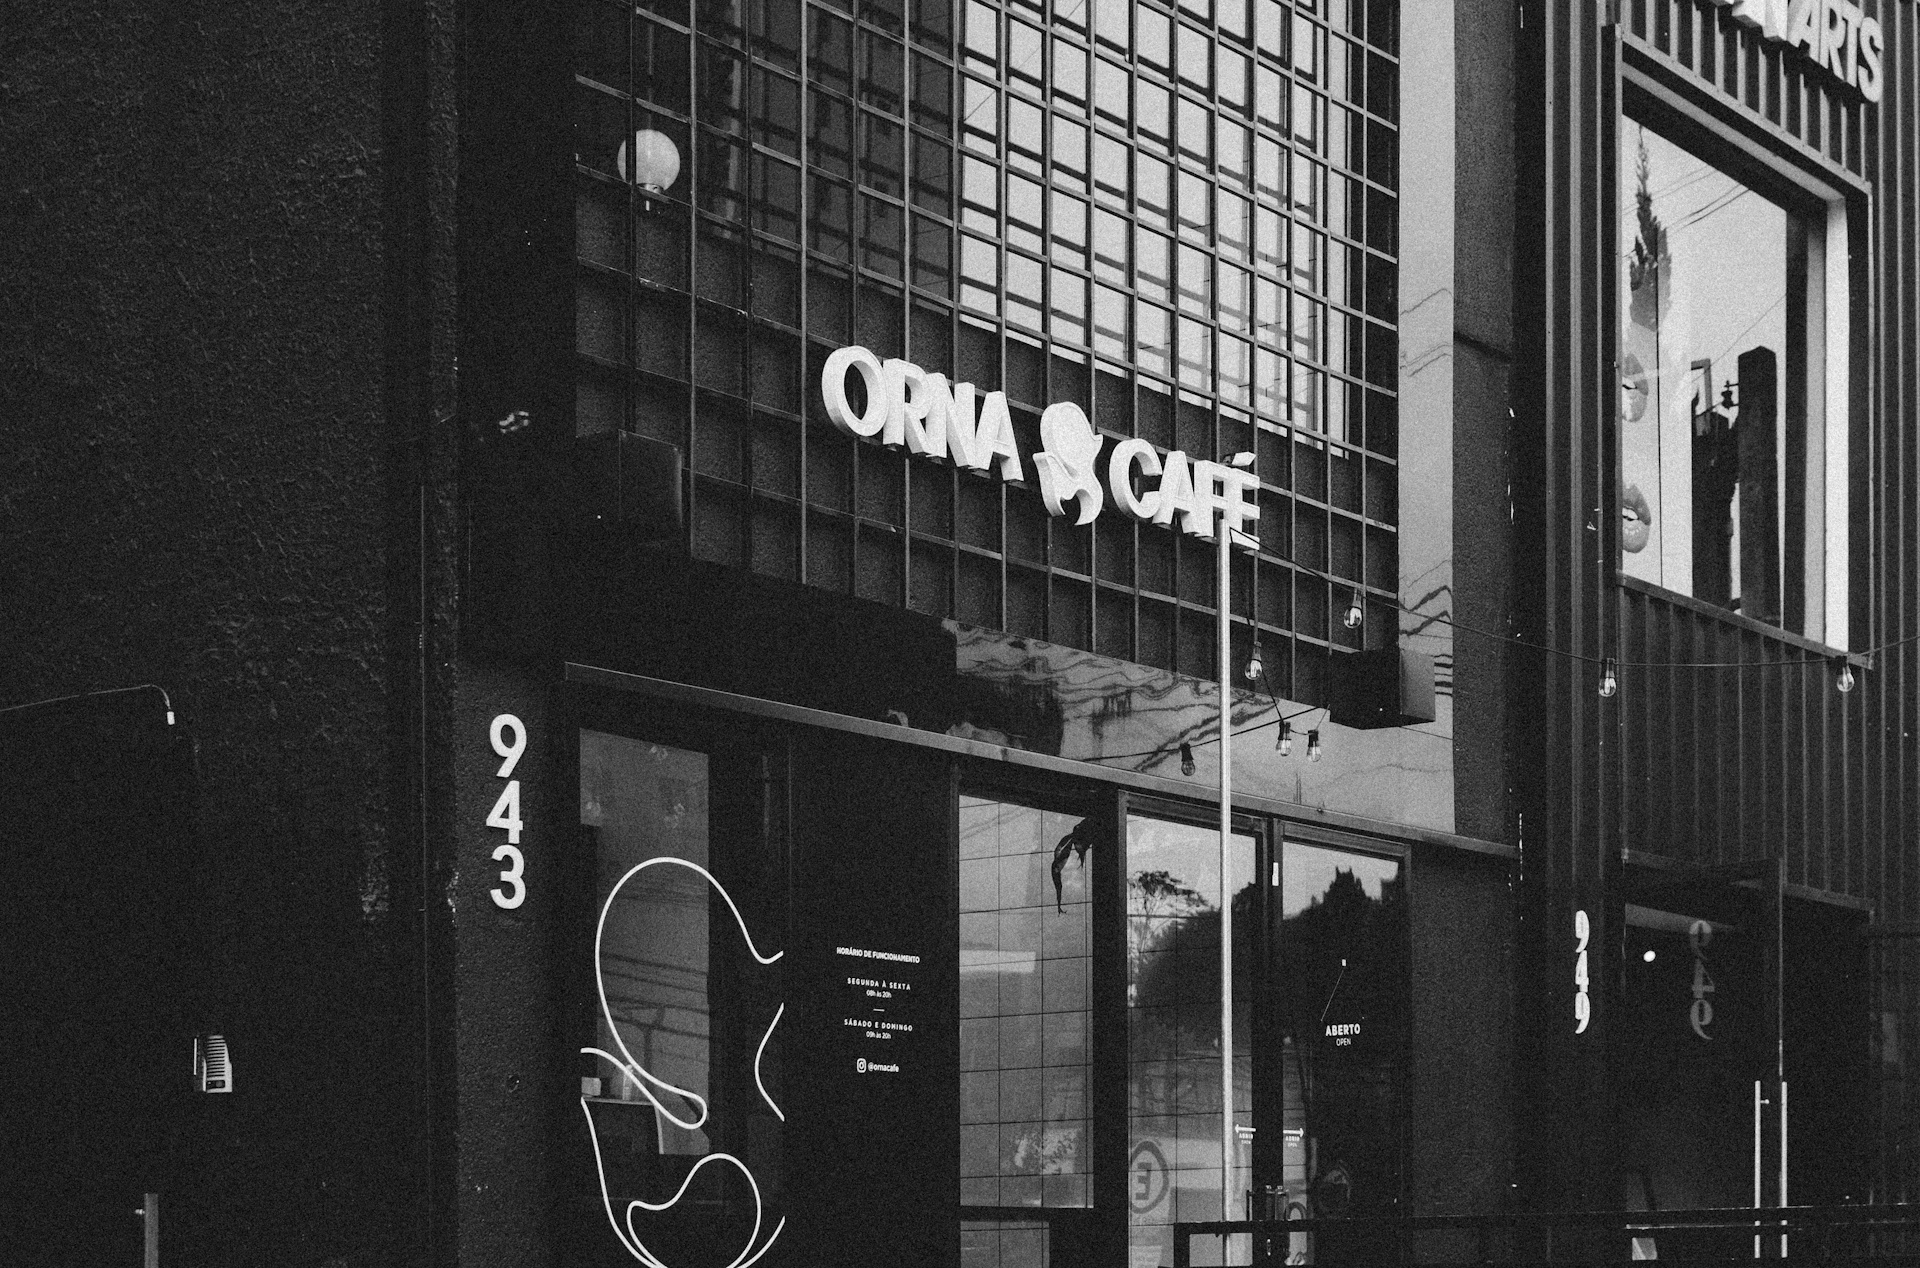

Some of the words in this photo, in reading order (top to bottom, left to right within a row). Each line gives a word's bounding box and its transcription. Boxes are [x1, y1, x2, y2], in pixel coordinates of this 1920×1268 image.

[821, 345, 1024, 482] ORNA
[1109, 438, 1261, 551] CAFÉ
[486, 713, 527, 909] 943
[836, 946, 863, 957] HORÁRIO
[864, 950, 872, 958] DE
[872, 951, 921, 964] FUNCIONAMENTO
[847, 977, 880, 988] SEGUNDA
[889, 981, 911, 991] SEXTA
[844, 1017, 872, 1028] SÁBADO
[874, 1021, 879, 1029] E
[881, 1022, 913, 1032] DOMINGO
[1325, 1023, 1361, 1036] ABERTO
[1336, 1037, 1352, 1046] OPEN
